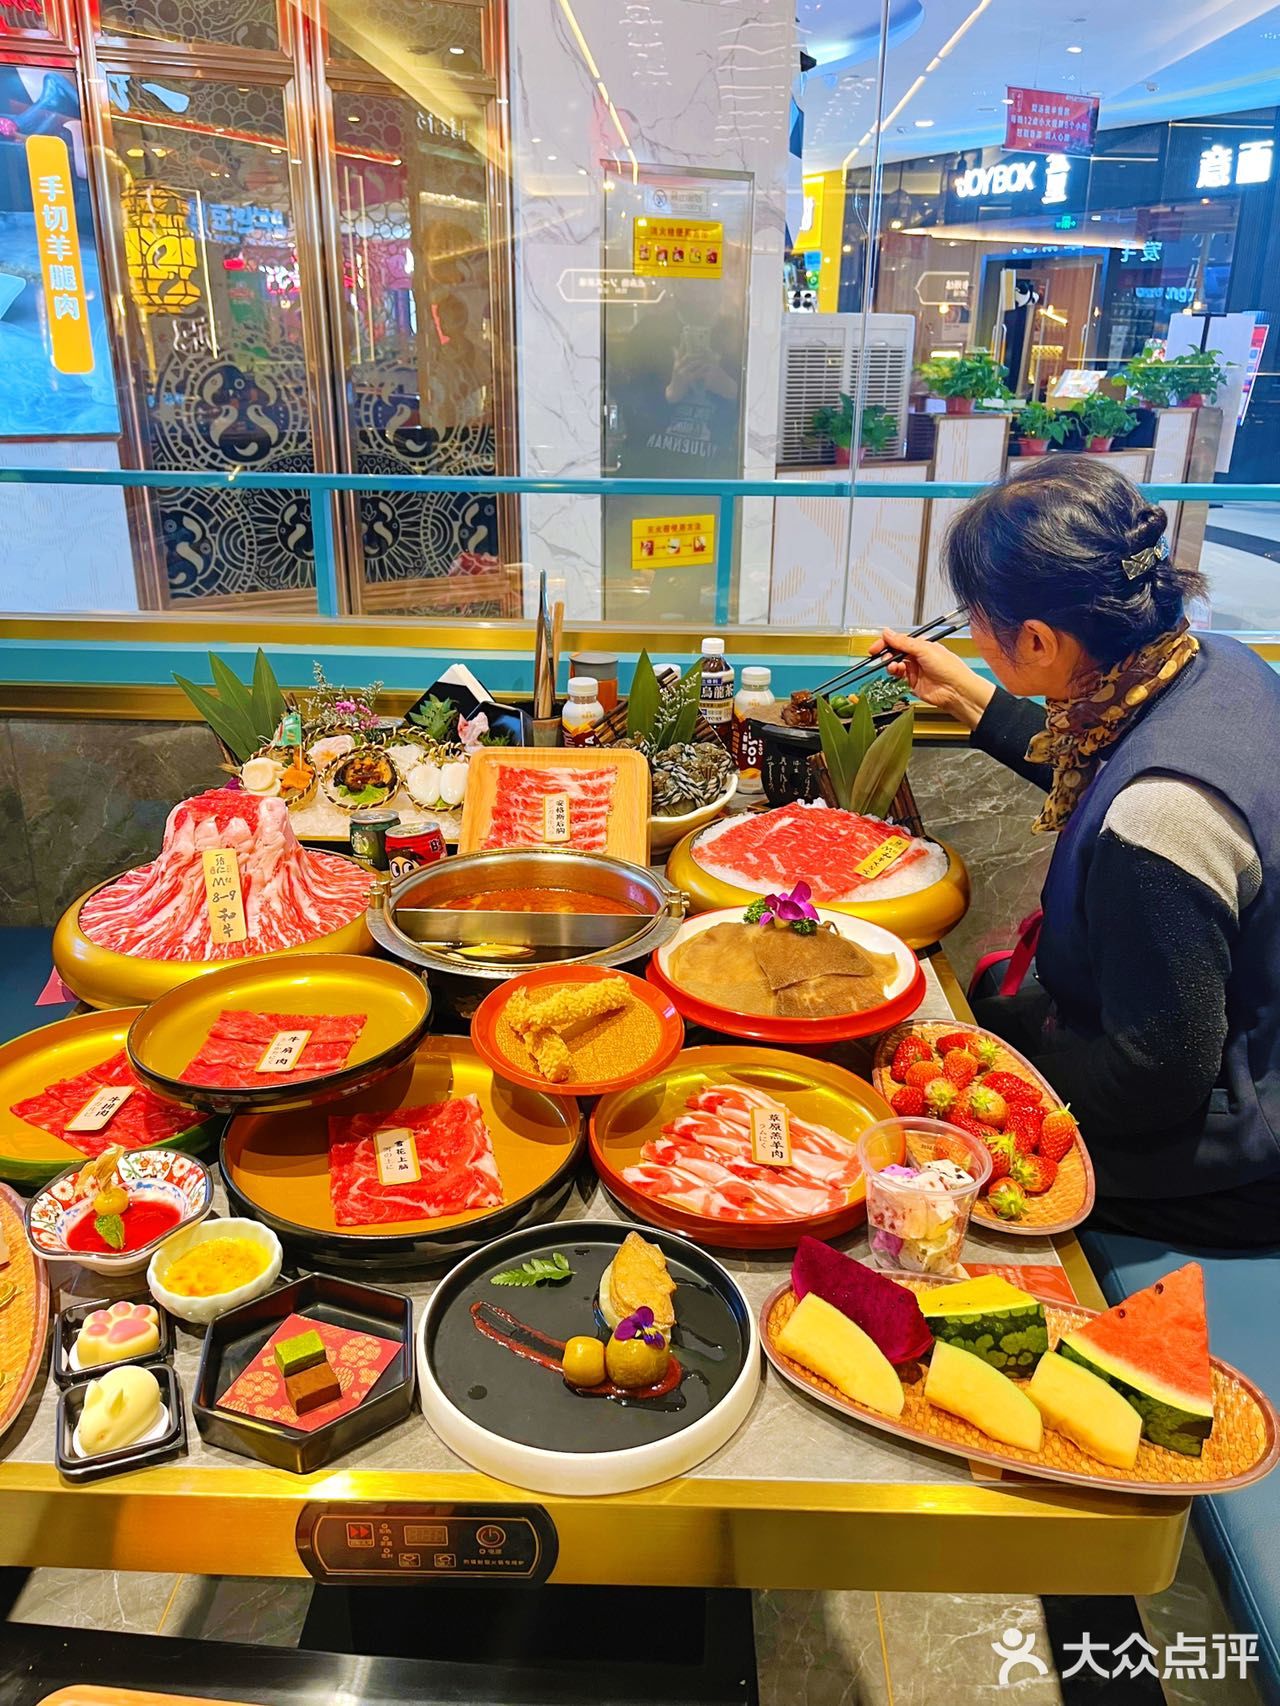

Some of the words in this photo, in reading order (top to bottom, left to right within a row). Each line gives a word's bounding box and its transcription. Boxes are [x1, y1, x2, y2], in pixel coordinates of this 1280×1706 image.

[955, 161, 1036, 198] JOYBOX
[1196, 140, 1274, 188] 意面
[38, 175, 81, 320] 手切羊腿肉
